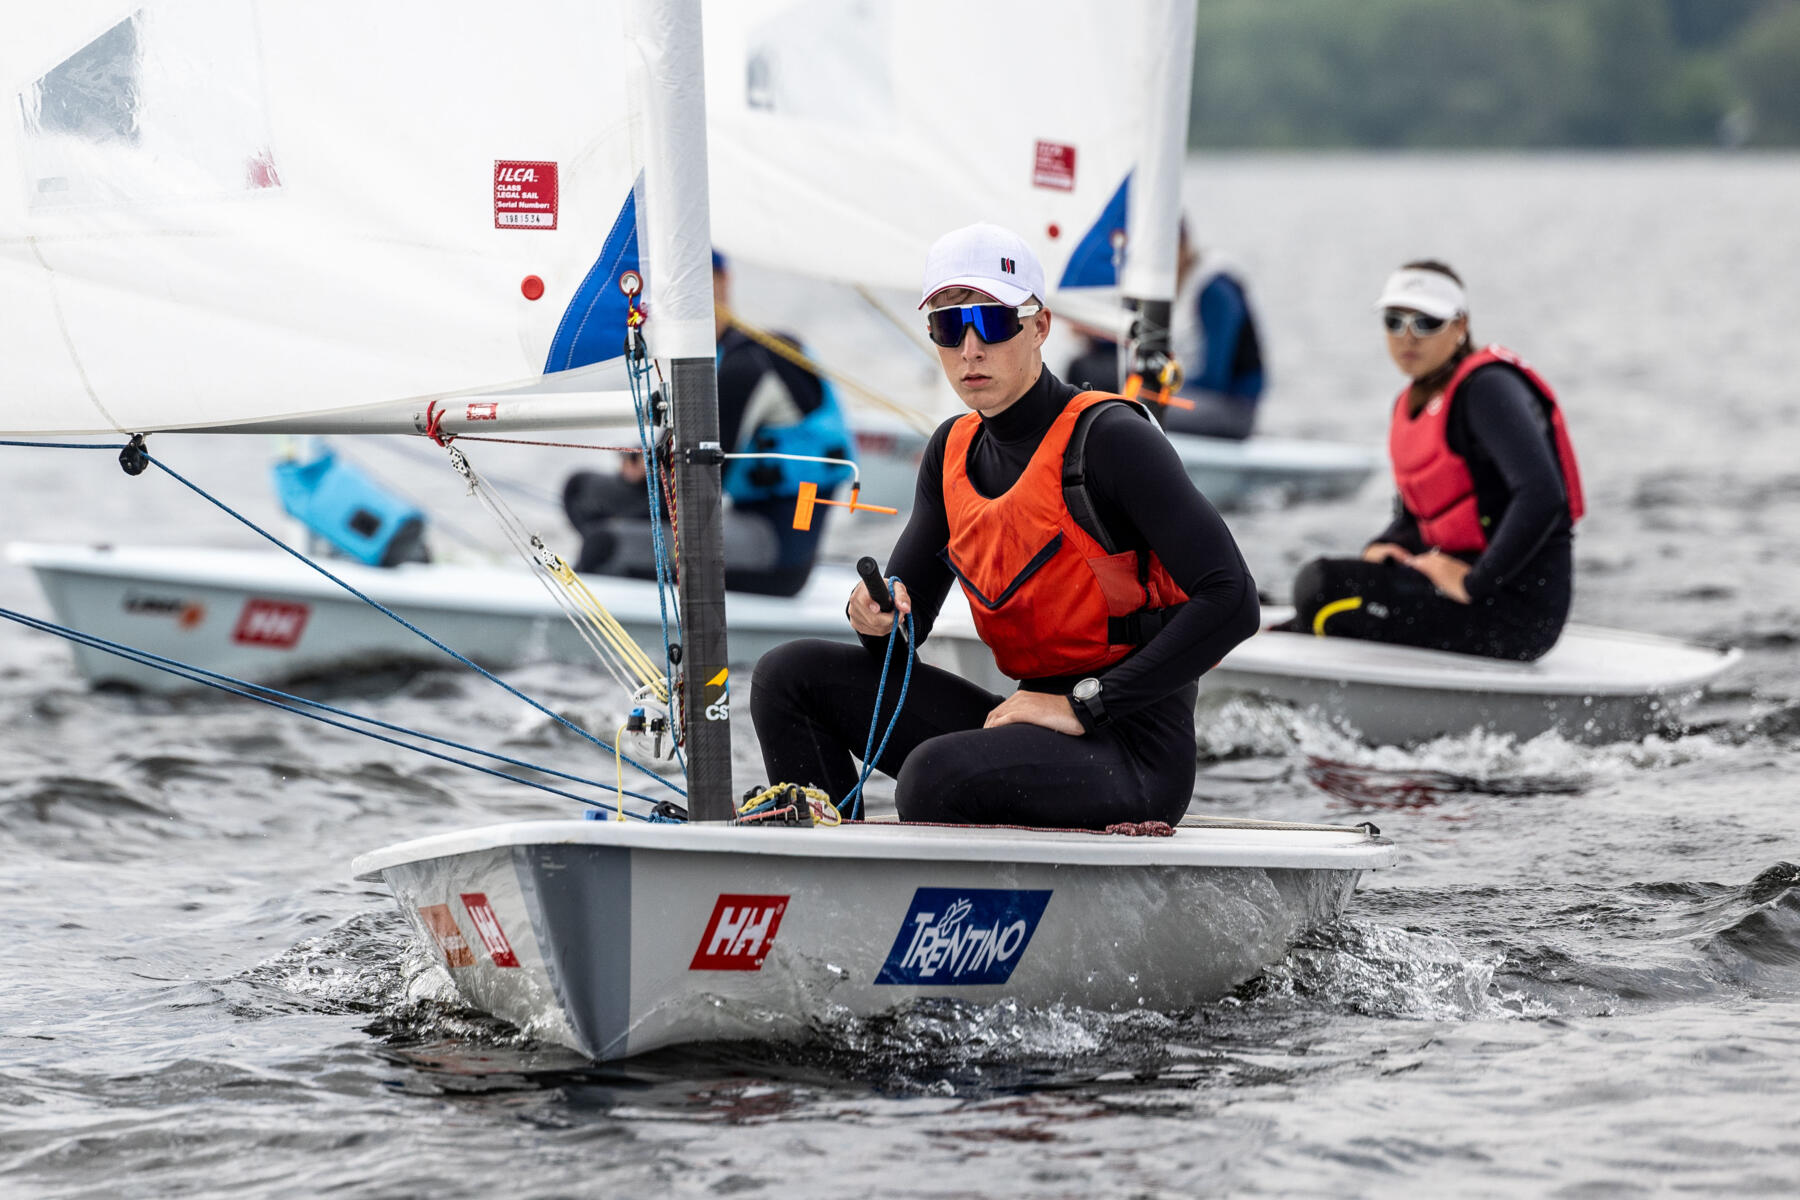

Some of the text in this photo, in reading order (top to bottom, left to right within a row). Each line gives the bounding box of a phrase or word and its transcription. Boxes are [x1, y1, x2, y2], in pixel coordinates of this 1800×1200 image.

[498, 167, 535, 182] ILCA
[497, 191, 521, 199] LEGAL
[497, 200, 518, 208] Serial
[705, 704, 730, 721] CS
[705, 906, 776, 956] HH
[900, 912, 1027, 978] TRENTINO
